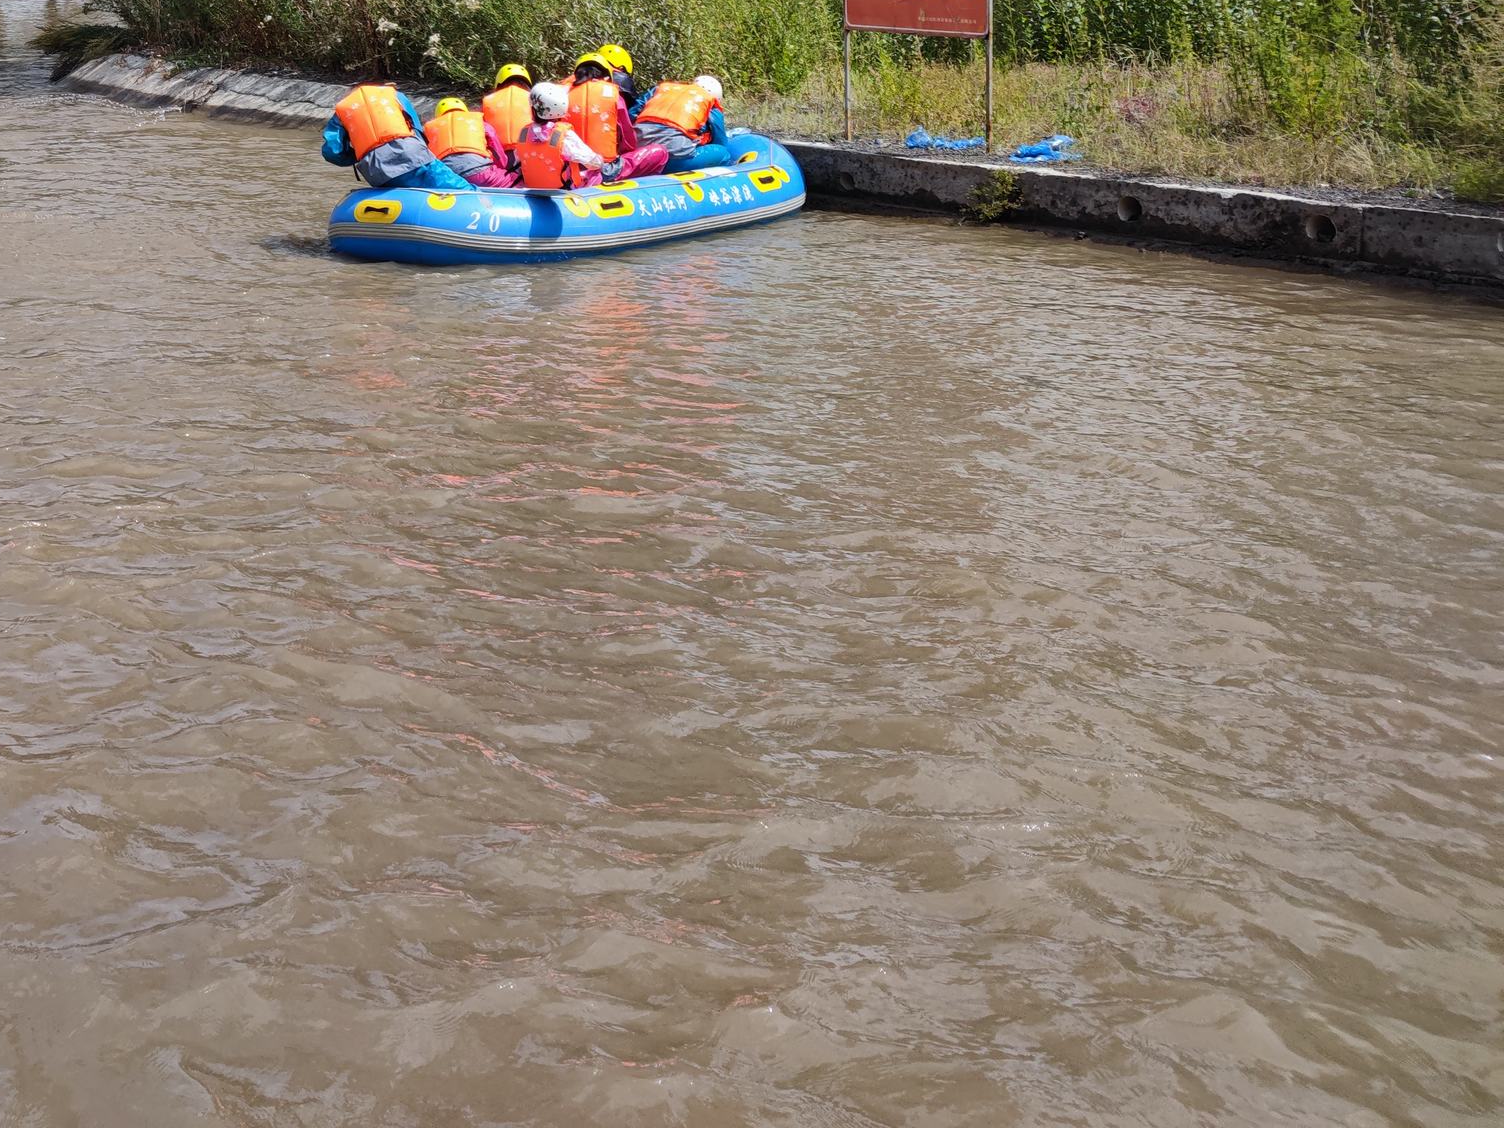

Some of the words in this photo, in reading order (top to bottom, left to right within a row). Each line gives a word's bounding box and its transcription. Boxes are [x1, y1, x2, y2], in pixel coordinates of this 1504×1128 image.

[637, 193, 688, 217] 天山红河
[708, 183, 755, 207] 峡谷漂流
[466, 211, 501, 233] 20
